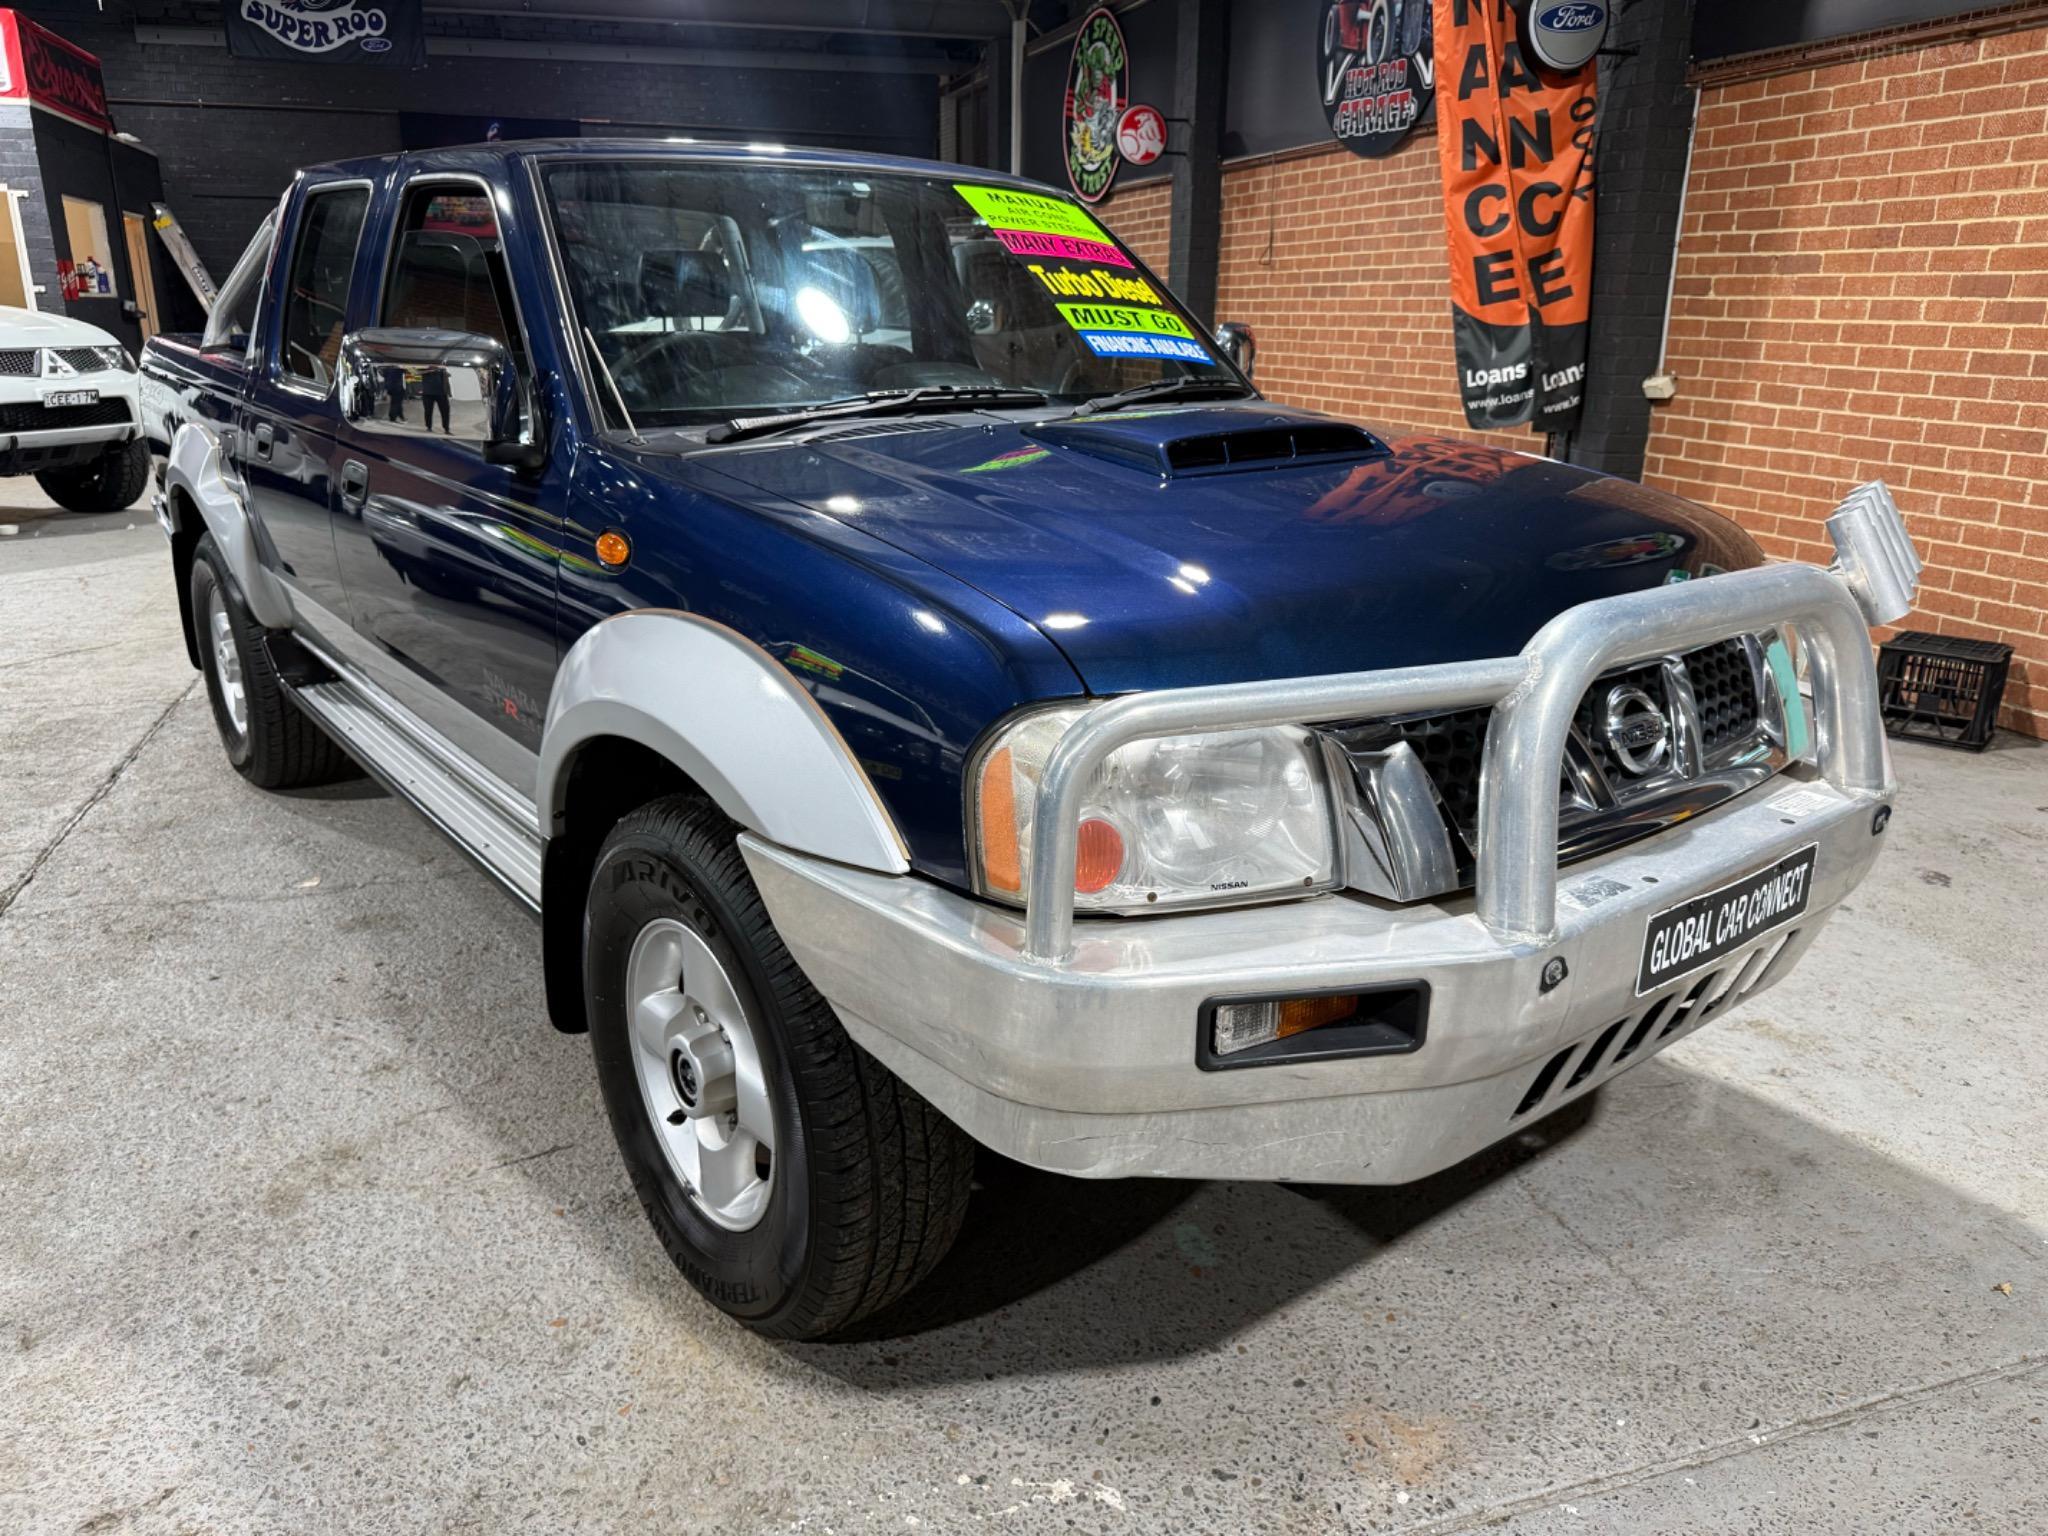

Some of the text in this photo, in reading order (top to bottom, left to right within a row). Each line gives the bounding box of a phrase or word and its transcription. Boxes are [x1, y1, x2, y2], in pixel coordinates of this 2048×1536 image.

[246, 1, 384, 48] SUPER ROO
[1552, 4, 1595, 28] Ford
[1344, 58, 1408, 98] HOT ROD
[1338, 89, 1412, 138] GARAGE
[987, 192, 1068, 214] MANUAL
[1007, 207, 1031, 215] AIR
[988, 214, 1038, 227] POWER
[1001, 233, 1125, 263] MANY EXTRAS
[1027, 264, 1163, 306] Turbo Diesel
[1069, 307, 1144, 328] MUST
[1085, 334, 1210, 361] FINANCING AVAILABLE
[1466, 362, 1527, 388] Loans
[1620, 719, 1662, 747] NISS
[616, 859, 717, 939] ARIVO
[1211, 880, 1249, 891] NISSAN
[1651, 862, 1809, 974] GLOBAL CAR CONNECT
[675, 1252, 762, 1304] TERRANO
